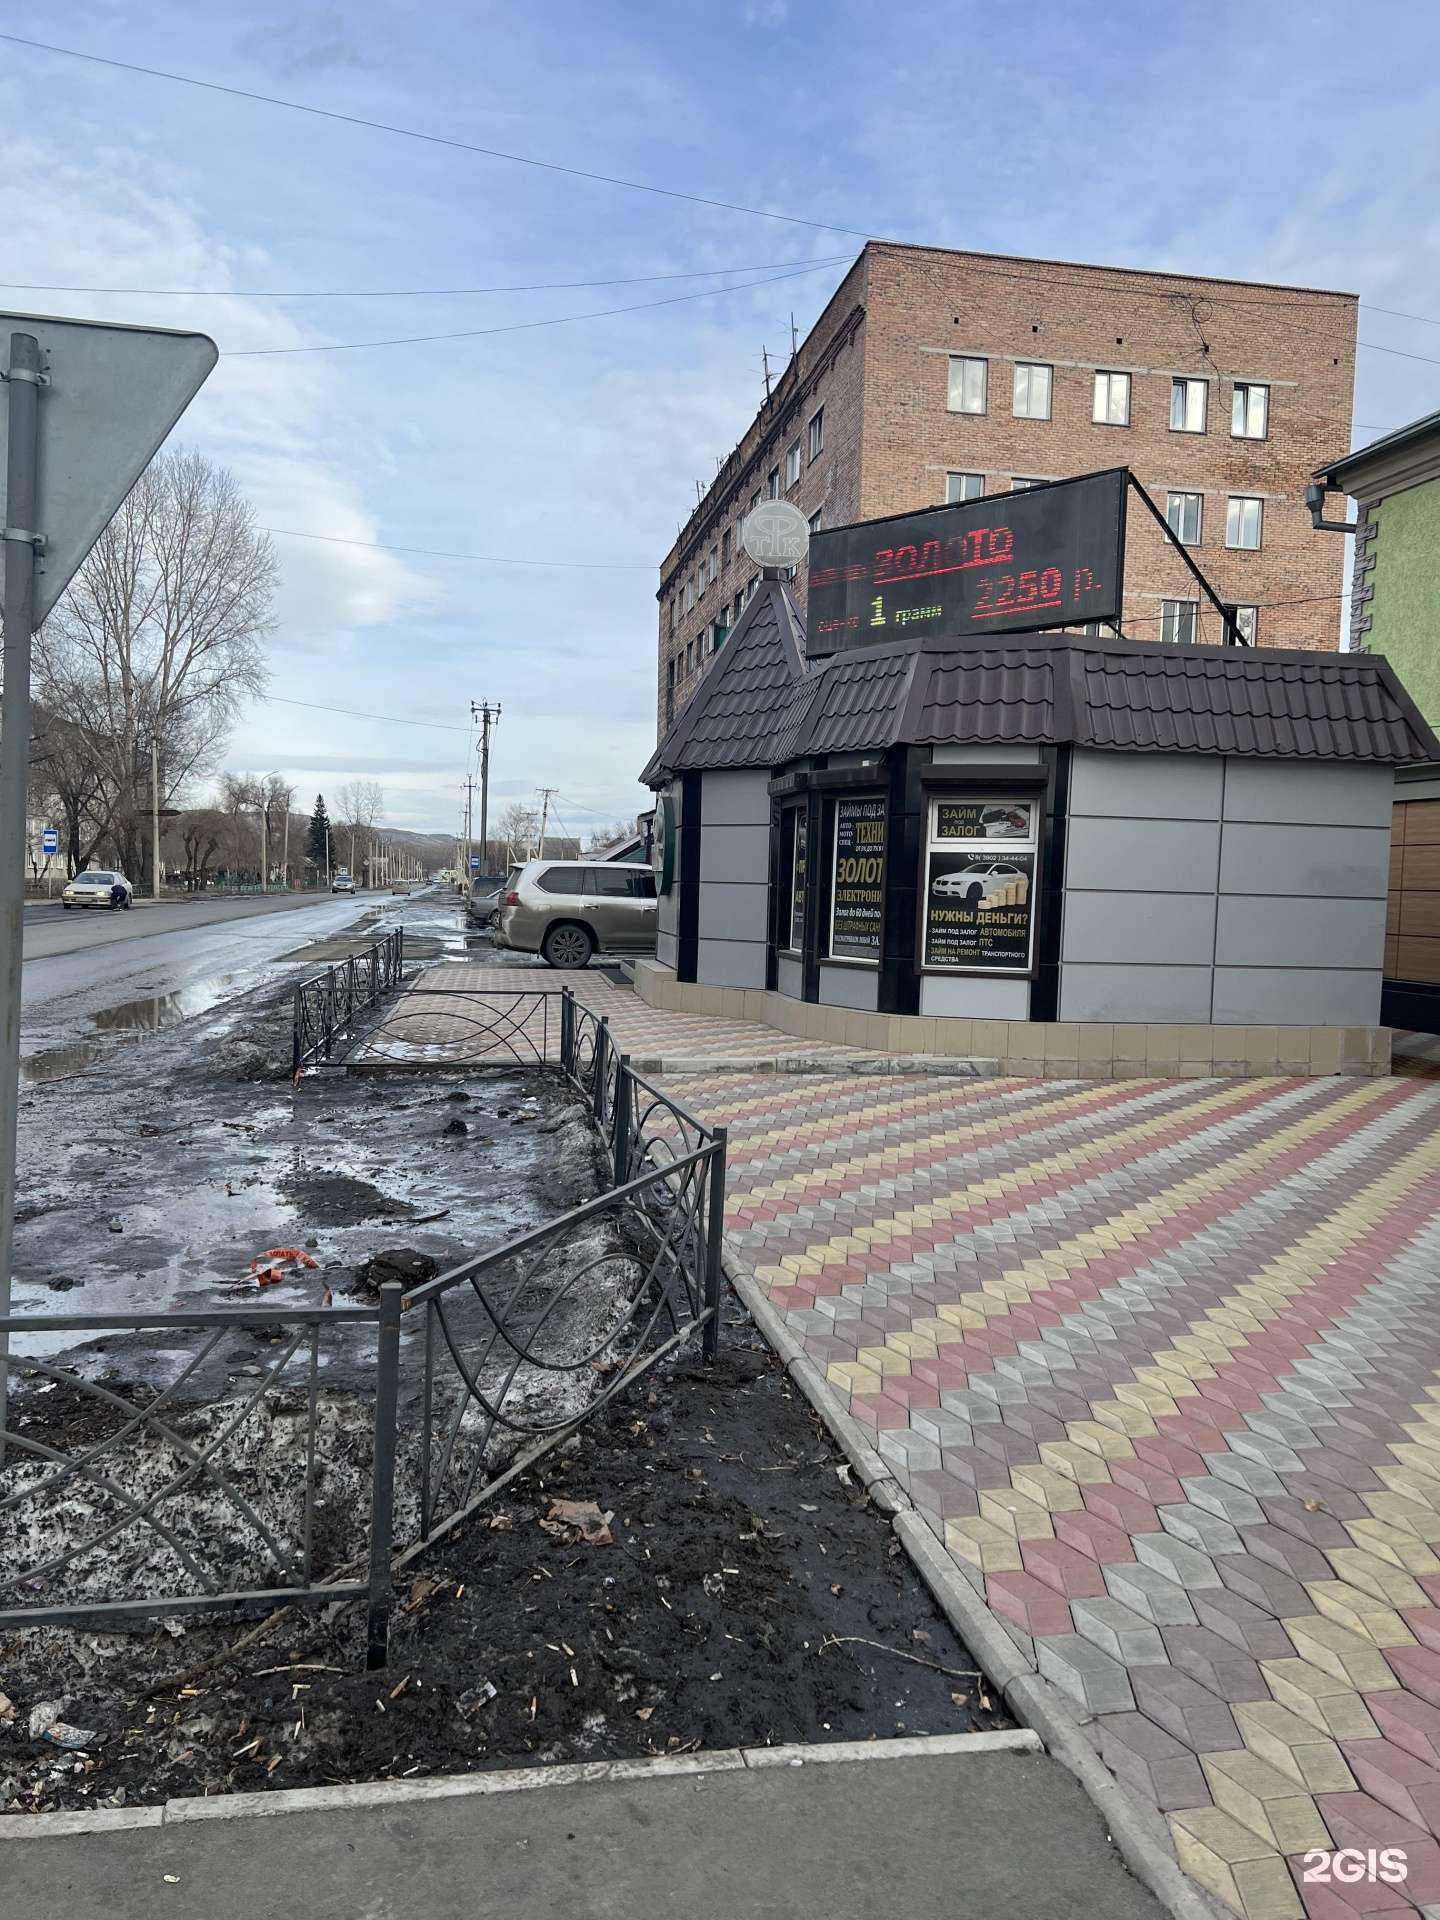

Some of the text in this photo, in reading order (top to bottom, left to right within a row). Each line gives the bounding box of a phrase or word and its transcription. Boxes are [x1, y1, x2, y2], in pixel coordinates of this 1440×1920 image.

[974, 567, 1062, 609] 2250
[870, 595, 886, 625] 1
[942, 806, 976, 819] ЗАЙМ
[942, 826, 980, 836] ЗАЛОГ
[930, 910, 1028, 925] НУЖНЫ ДЕНЬГИ?
[980, 928, 1026, 937] АВТОМОБИЛЯ
[979, 938, 993, 946] ПТС
[957, 948, 980, 956] РЕМОНТ
[982, 950, 1026, 958] ТРАНСПОРТНОГО
